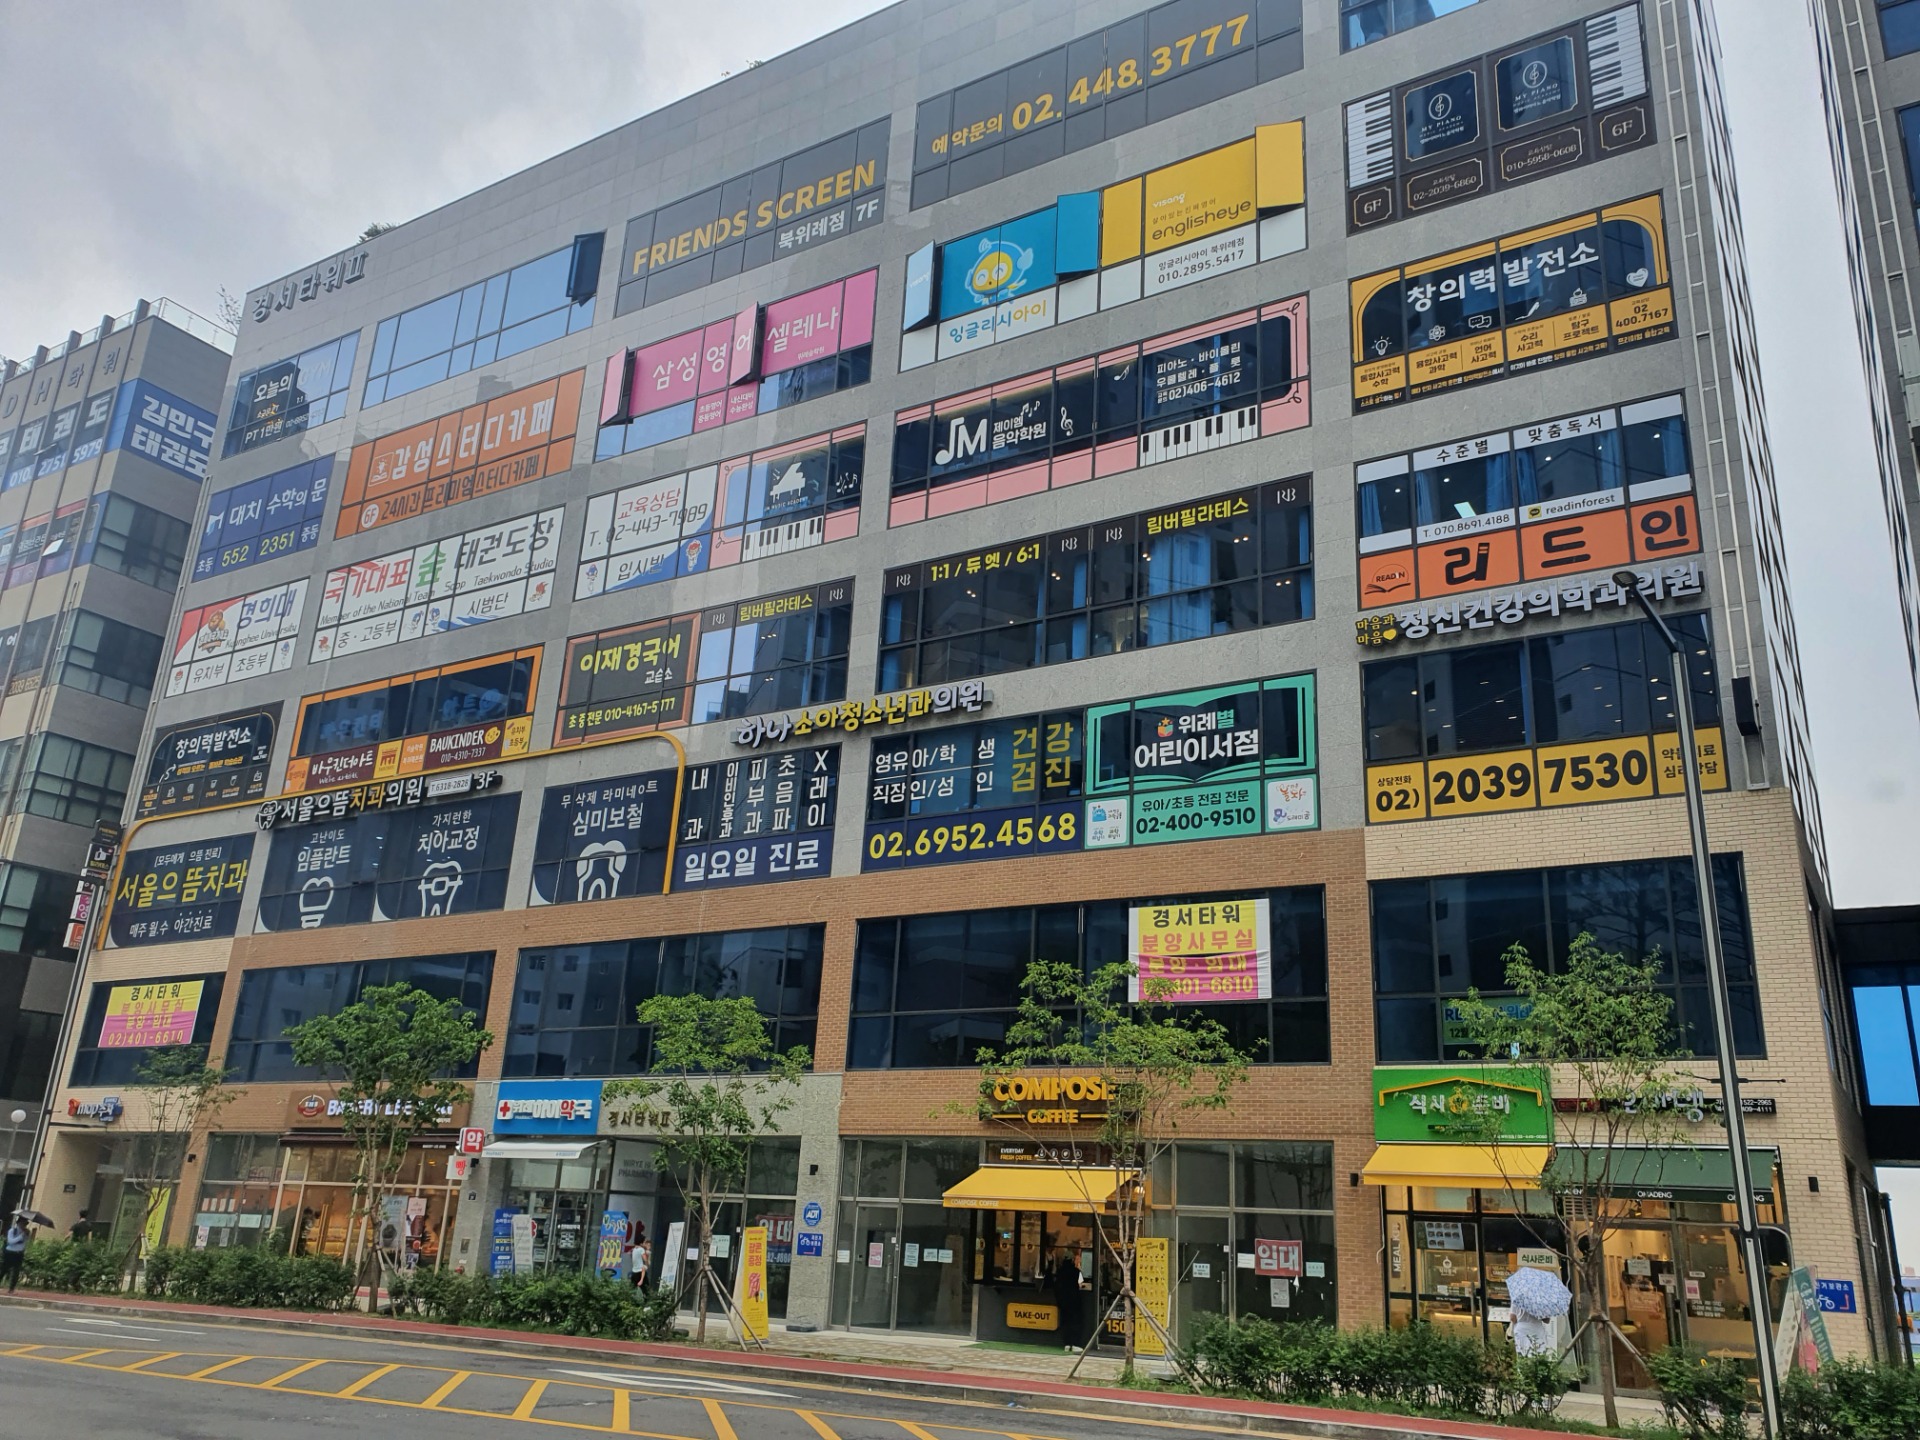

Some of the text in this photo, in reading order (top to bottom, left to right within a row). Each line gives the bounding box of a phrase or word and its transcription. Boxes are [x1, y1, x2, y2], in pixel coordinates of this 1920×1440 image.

[1611, 120, 1633, 136] 6F
[632, 158, 877, 277] FRIENDS SCREEN
[1151, 200, 1252, 240] englisheye
[1364, 199, 1383, 214] 6F
[778, 198, 881, 252] 북위례점 7F
[1157, 249, 1246, 284] 010.2895.5417
[1407, 241, 1600, 313] 창의력발전소
[949, 299, 1047, 343] 잉글리시아이
[1615, 308, 1669, 328] 400.7167
[1633, 304, 1648, 314] 02
[766, 306, 839, 354] 셀레나
[1520, 332, 1538, 343] 수리
[1157, 341, 1241, 374] 피아노 바이올린
[253, 372, 294, 403] 오늘의
[245, 428, 259, 445] PT
[391, 396, 556, 481] 감성스터디카페
[992, 416, 1024, 433] 제이엠
[992, 422, 1047, 450] 음악학원
[1436, 414, 1602, 463] 수준별 맞춤독서
[72, 438, 104, 463] 5979
[229, 478, 327, 527] 대치 수학의 문
[617, 487, 681, 519] 교육상담
[1546, 493, 1616, 515] readinforest
[363, 508, 378, 526] 6F
[606, 502, 709, 543] 02-443-7989
[1147, 498, 1250, 536] 림버필라테스
[1434, 513, 1510, 536] 070.8691.4188
[196, 524, 319, 573] 초등 552 2351 중등
[325, 558, 412, 604] 국가대표
[454, 516, 555, 569] 태권도장
[930, 542, 1041, 582] 1:1 듀엣 6:1
[617, 553, 665, 581] 입시반
[1376, 570, 1405, 584] READIN
[363, 602, 376, 615] the
[377, 593, 411, 611] National
[474, 566, 522, 587] Taekwondo
[524, 557, 554, 573] Studio
[237, 588, 298, 630] 경희대
[467, 592, 509, 616] 시범단
[740, 594, 813, 621] 림버필라테스
[260, 622, 298, 640] University
[1356, 614, 1396, 631] 마음과
[1356, 631, 1382, 645] 마음
[193, 652, 268, 683] 유치부 초등부
[580, 633, 681, 674] 이재경국어
[644, 666, 673, 685] 교습소
[1178, 708, 1235, 734] 위례별
[175, 726, 252, 760] 창의력발전소
[430, 729, 485, 753] BAUKINDER
[1012, 721, 1074, 760] 건강
[1134, 728, 1259, 769] 어린이서점
[312, 750, 374, 776] 바우킨더아트
[1011, 756, 1072, 793] 검진
[772, 754, 796, 831] 초음파
[1375, 749, 1648, 812] 02) 2039 7530
[1377, 775, 1412, 786] 상담전화
[280, 777, 425, 822] 서울으뜸치과의원
[476, 771, 494, 790] 3F
[561, 790, 597, 809] 무삭제
[743, 758, 769, 835] 피부과
[1142, 789, 1250, 813] 유아/초등 전집 전문
[432, 810, 472, 827] 가지런한
[572, 802, 644, 837] 심미보철
[1136, 807, 1256, 834] 02-400-9510
[310, 828, 344, 844] 고난이도
[418, 825, 480, 855] 치아교정
[869, 812, 1076, 859] 02.6952.4568
[297, 844, 350, 872] 임플란트
[685, 839, 819, 883] 일요일 진료
[117, 859, 248, 908] 서울으뜸치과
[129, 915, 213, 938] 매주 야간진료
[1152, 904, 1240, 928] 경서타워
[1142, 928, 1253, 953] 분양사무실
[131, 984, 181, 1001] 경서타워
[121, 999, 184, 1015] 분양사무실
[108, 1029, 184, 1046] 02)401-6610
[993, 1076, 1116, 1101] COMPOSE
[1027, 1109, 1079, 1123] COFFEE
[467, 1131, 483, 1150] 약
[806, 1209, 819, 1219] ADT
[1257, 1244, 1299, 1272] 임대
[1521, 1253, 1553, 1264] 식사준비
